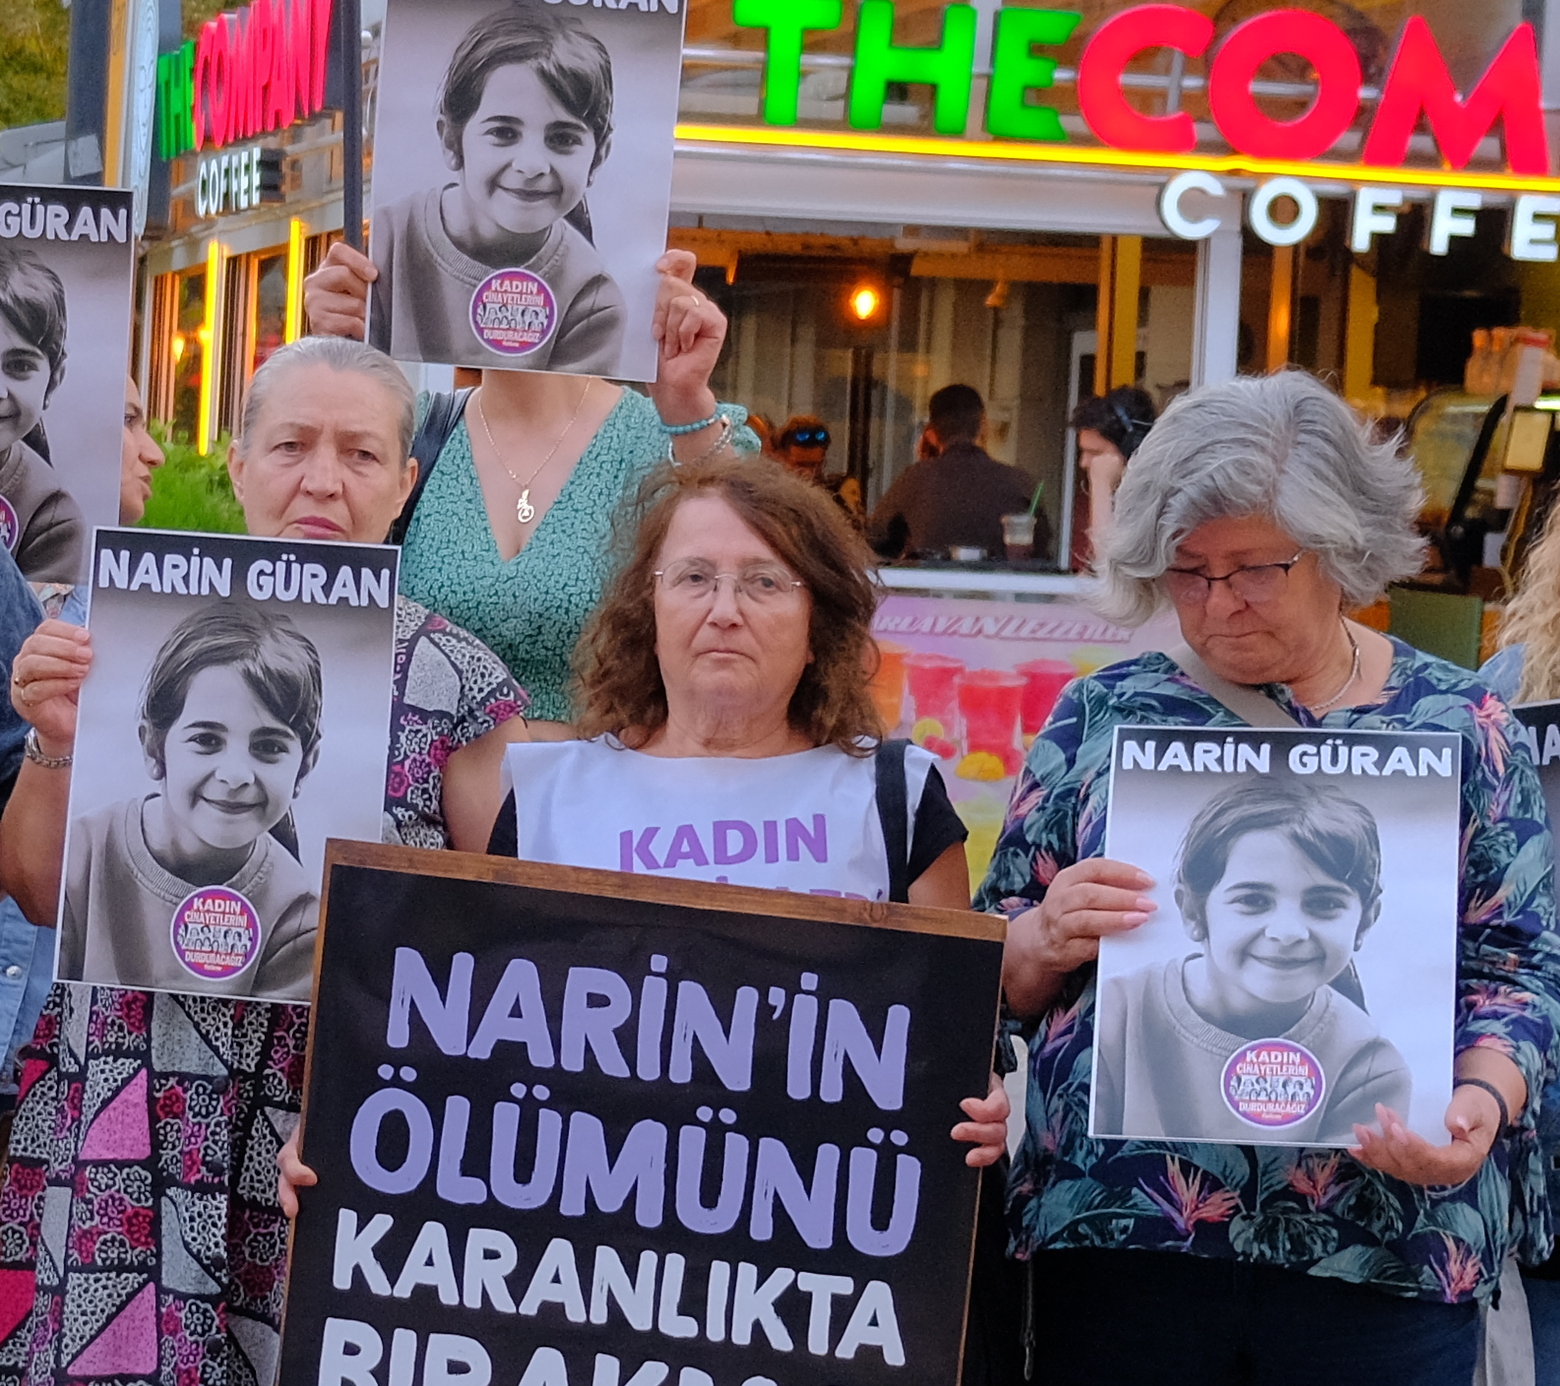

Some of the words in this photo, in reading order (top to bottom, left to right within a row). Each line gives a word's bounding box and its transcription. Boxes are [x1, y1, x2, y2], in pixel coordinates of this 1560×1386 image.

[195, 147, 263, 219] COFFEE
[491, 278, 539, 295] KADIN
[97, 547, 233, 598] NARİN
[246, 554, 391, 608] GÜRAN
[1121, 736, 1271, 773] NARİN
[1288, 739, 1453, 777] GÜRAN
[619, 813, 828, 873] KADIN
[192, 897, 242, 914] KADIN
[385, 946, 911, 1111] NARİN'İN
[1246, 1049, 1302, 1064] KADIN
[349, 1064, 922, 1258] ÖLÜMÜNÜ
[331, 1207, 908, 1367] KARANLIKTA
